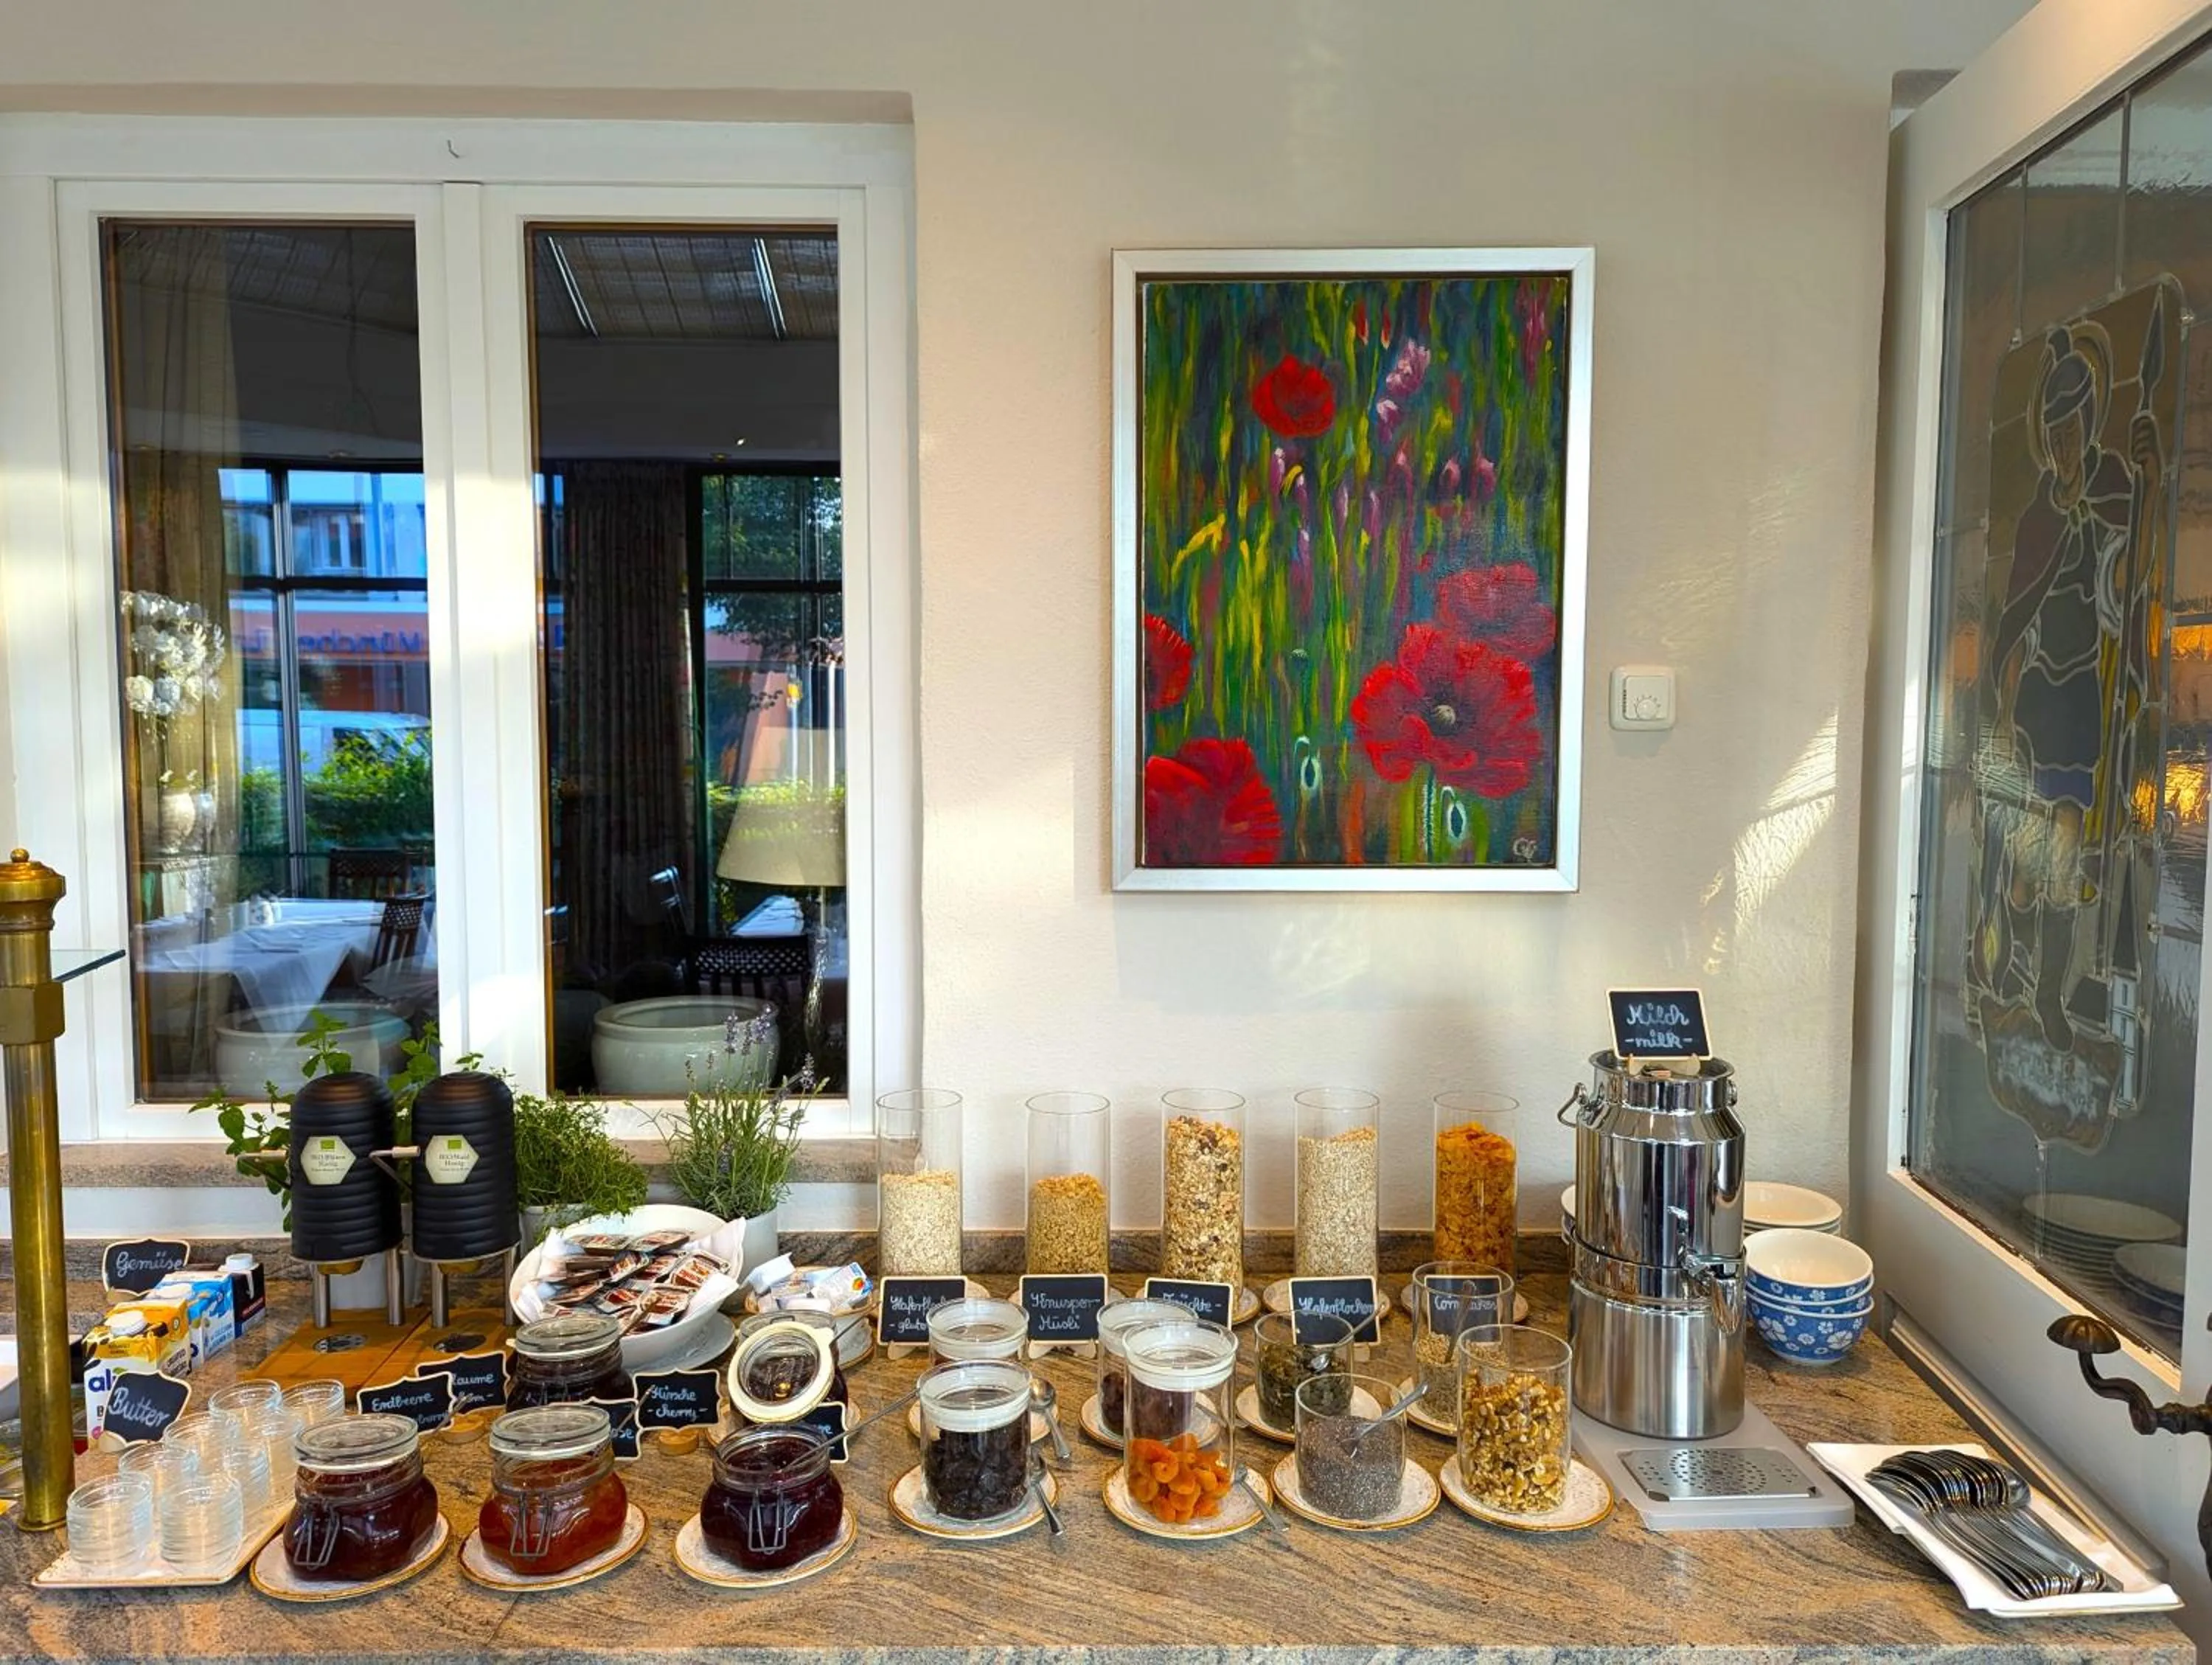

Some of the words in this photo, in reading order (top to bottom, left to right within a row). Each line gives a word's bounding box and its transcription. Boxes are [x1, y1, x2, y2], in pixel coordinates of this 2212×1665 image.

[1627, 1002, 1689, 1026] Milch
[116, 1251, 183, 1278] Gemüse
[1038, 1315, 1080, 1331] Müsli
[108, 1386, 170, 1428] Butter
[372, 1391, 434, 1412] Erdbeere
